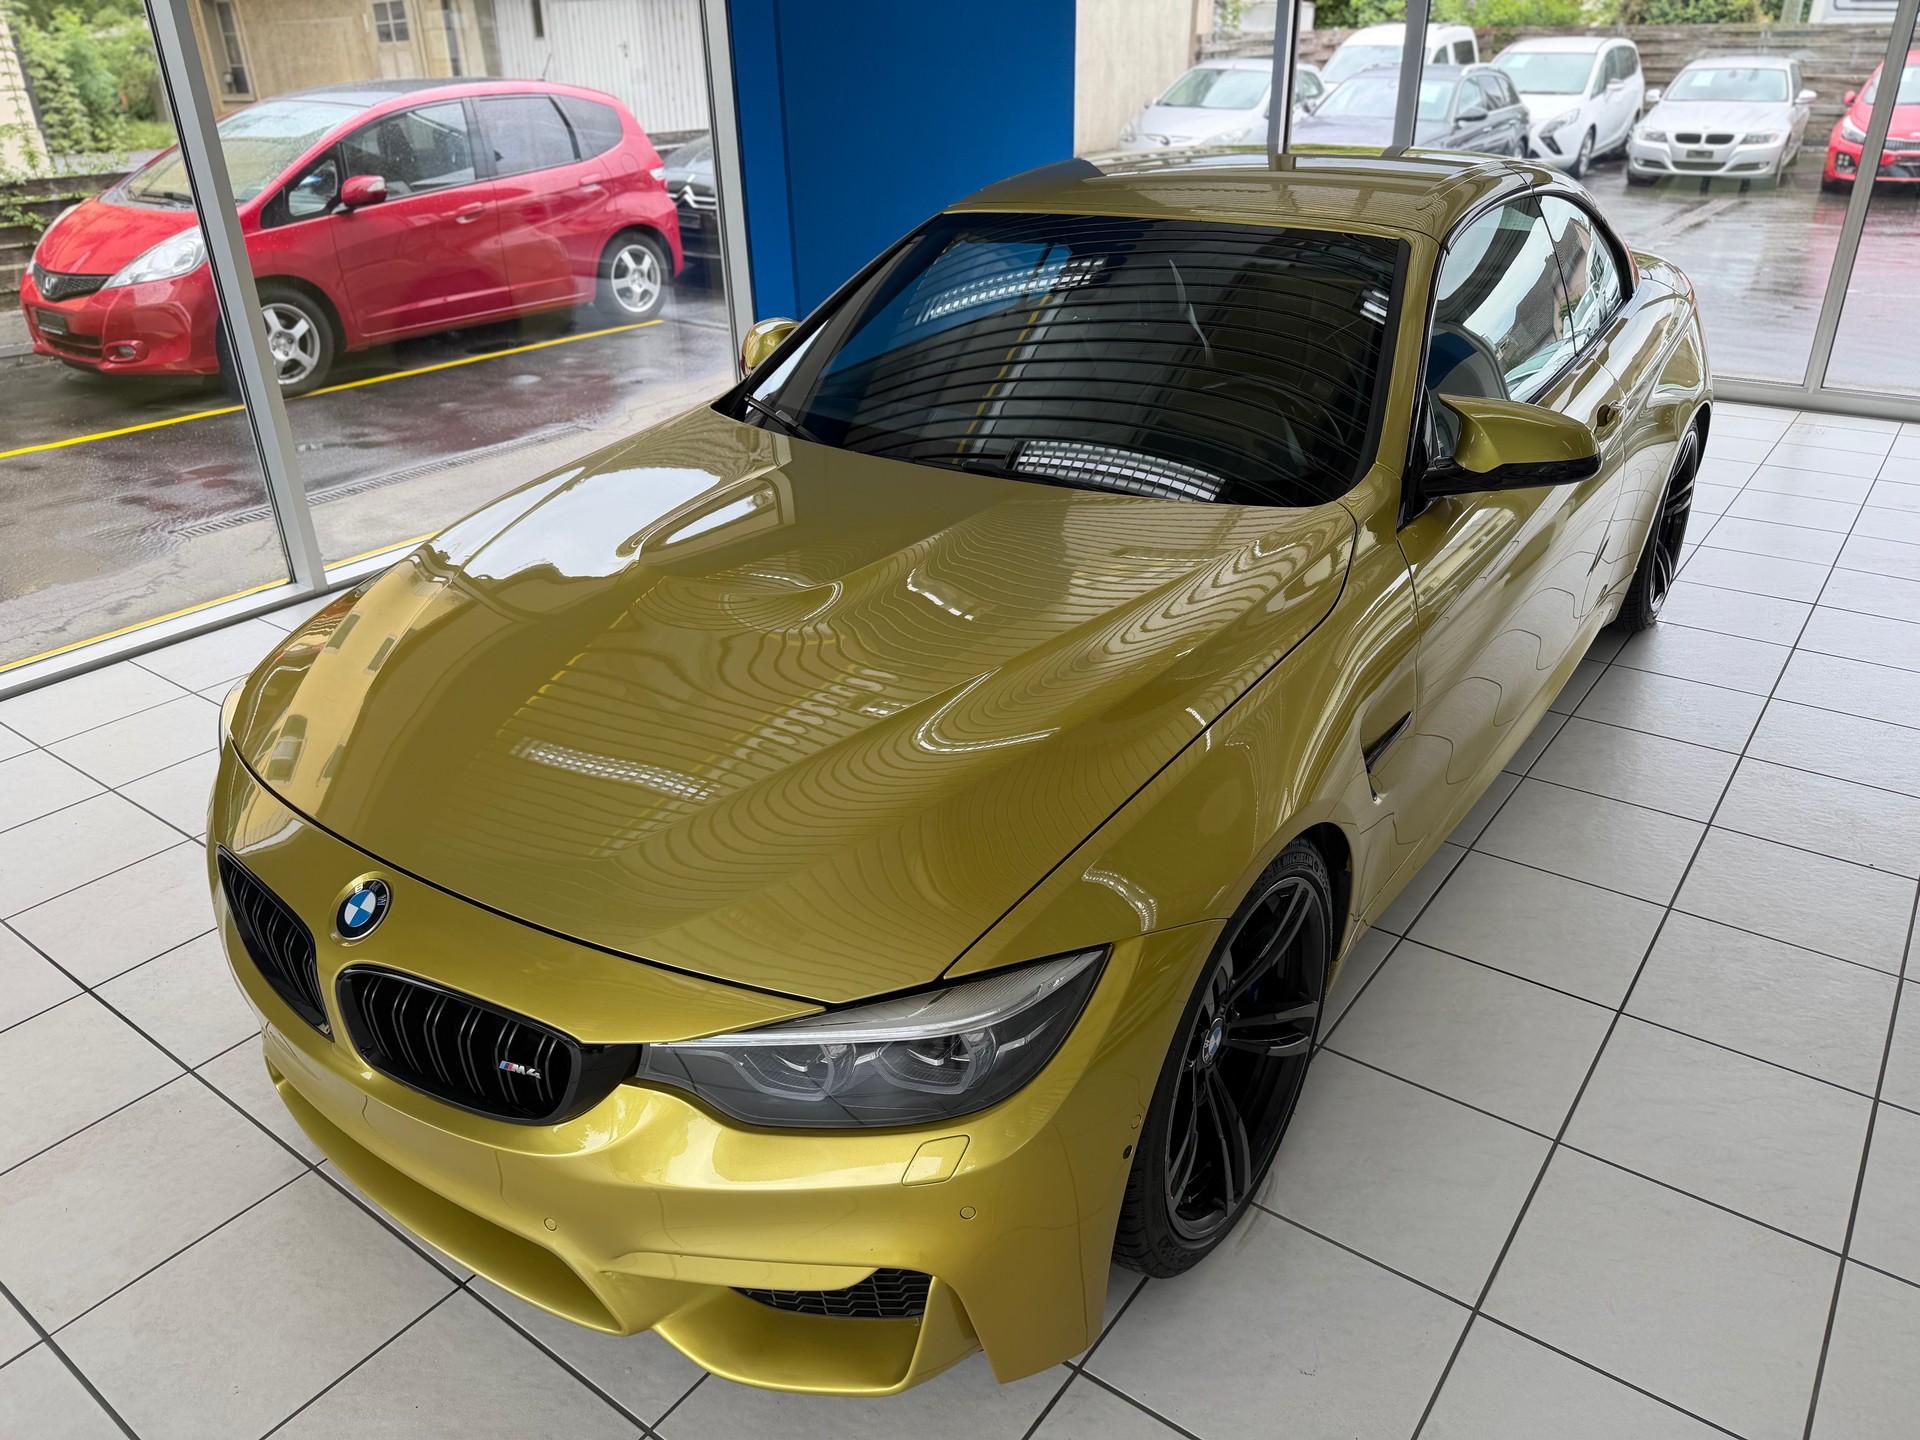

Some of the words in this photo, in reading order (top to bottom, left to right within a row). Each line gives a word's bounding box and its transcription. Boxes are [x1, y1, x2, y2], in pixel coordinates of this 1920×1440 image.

[1283, 852, 1314, 867] MICHELIN
[355, 881, 386, 906] BMW
[511, 1063, 541, 1080] M4
